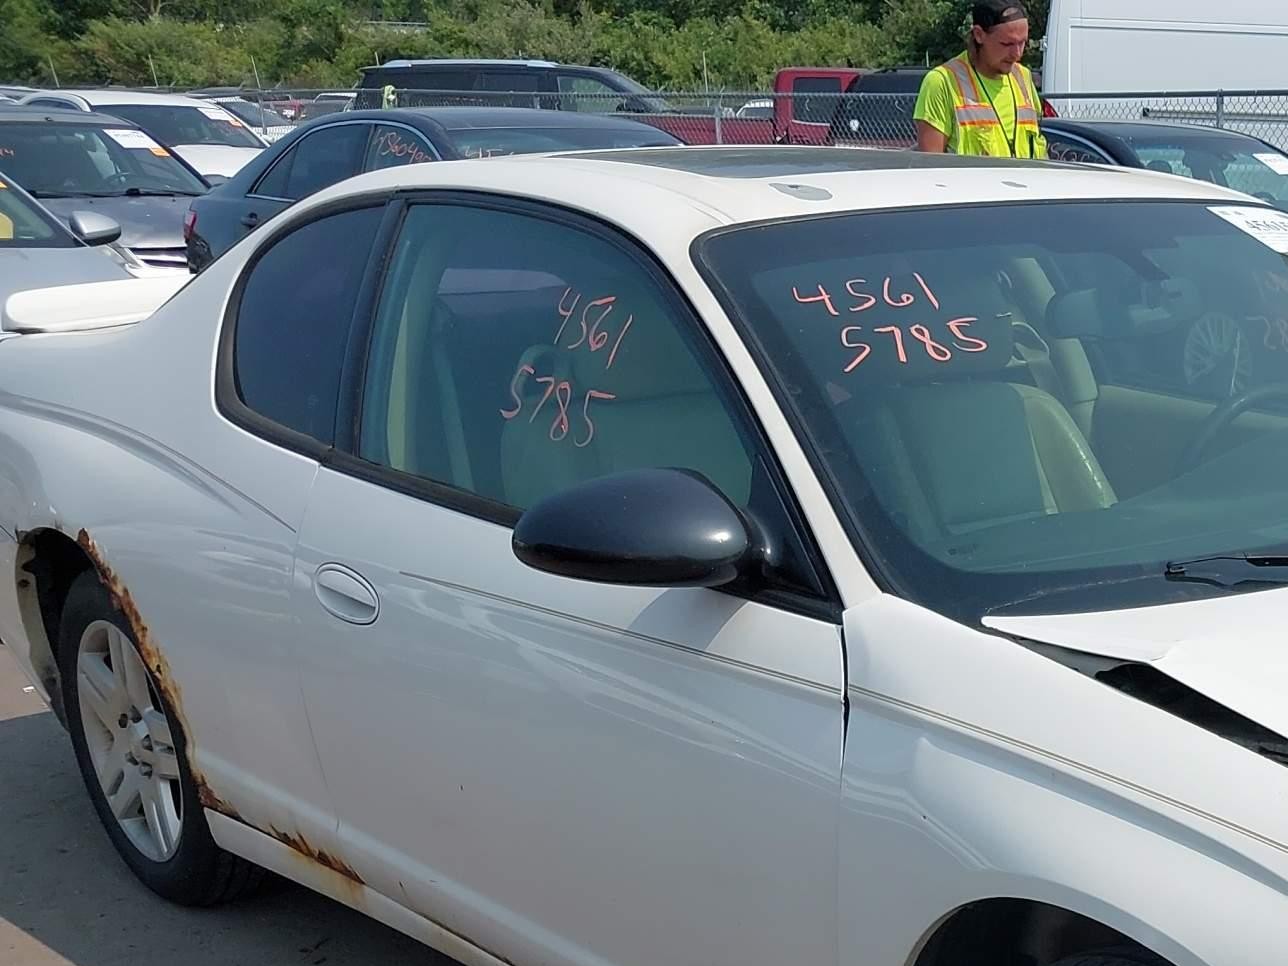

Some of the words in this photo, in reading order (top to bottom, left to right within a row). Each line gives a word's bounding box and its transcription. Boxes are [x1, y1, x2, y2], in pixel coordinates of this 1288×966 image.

[554, 287, 633, 370] 4561
[792, 272, 940, 316] 4561
[841, 317, 988, 373] 5785
[500, 365, 616, 447] 5785
